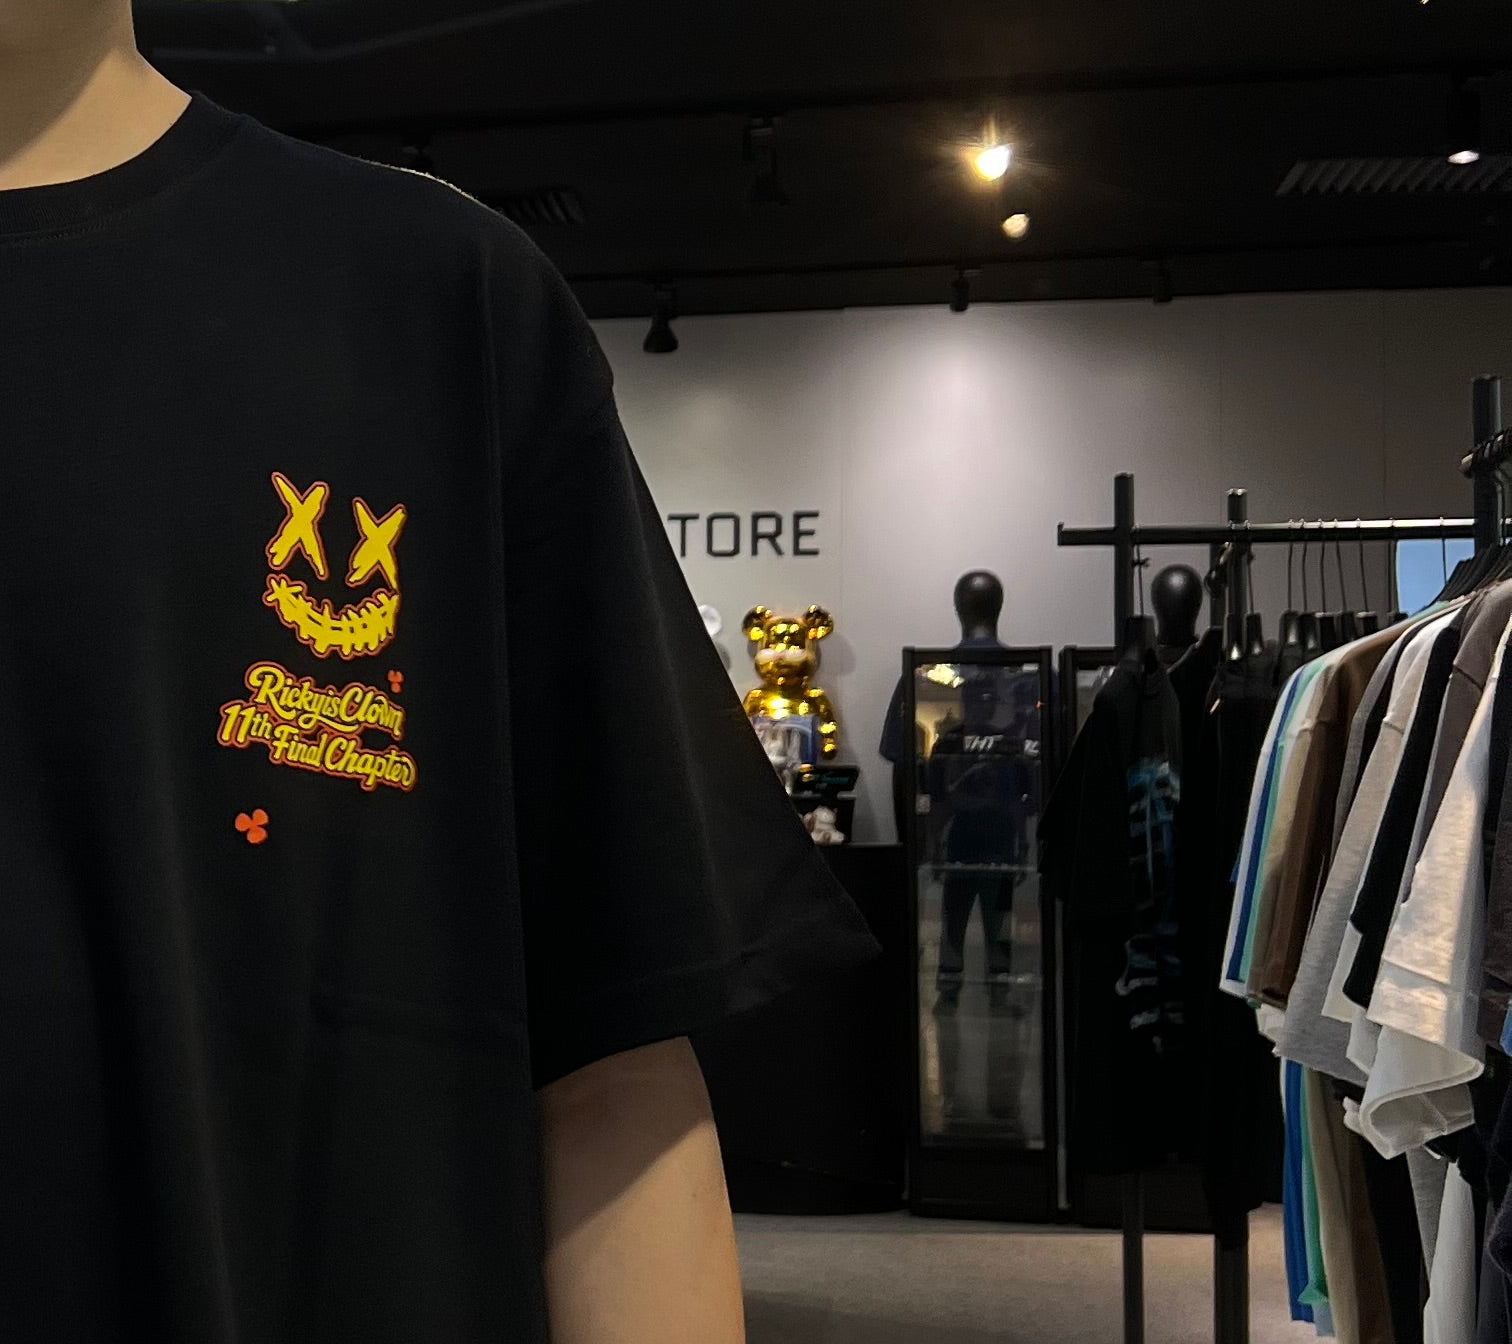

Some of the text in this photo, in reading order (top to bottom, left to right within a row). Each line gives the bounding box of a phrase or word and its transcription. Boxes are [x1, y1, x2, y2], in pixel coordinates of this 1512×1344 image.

[667, 511, 820, 557] TORE
[272, 725, 328, 767] Final
[325, 736, 416, 787] Chapter
